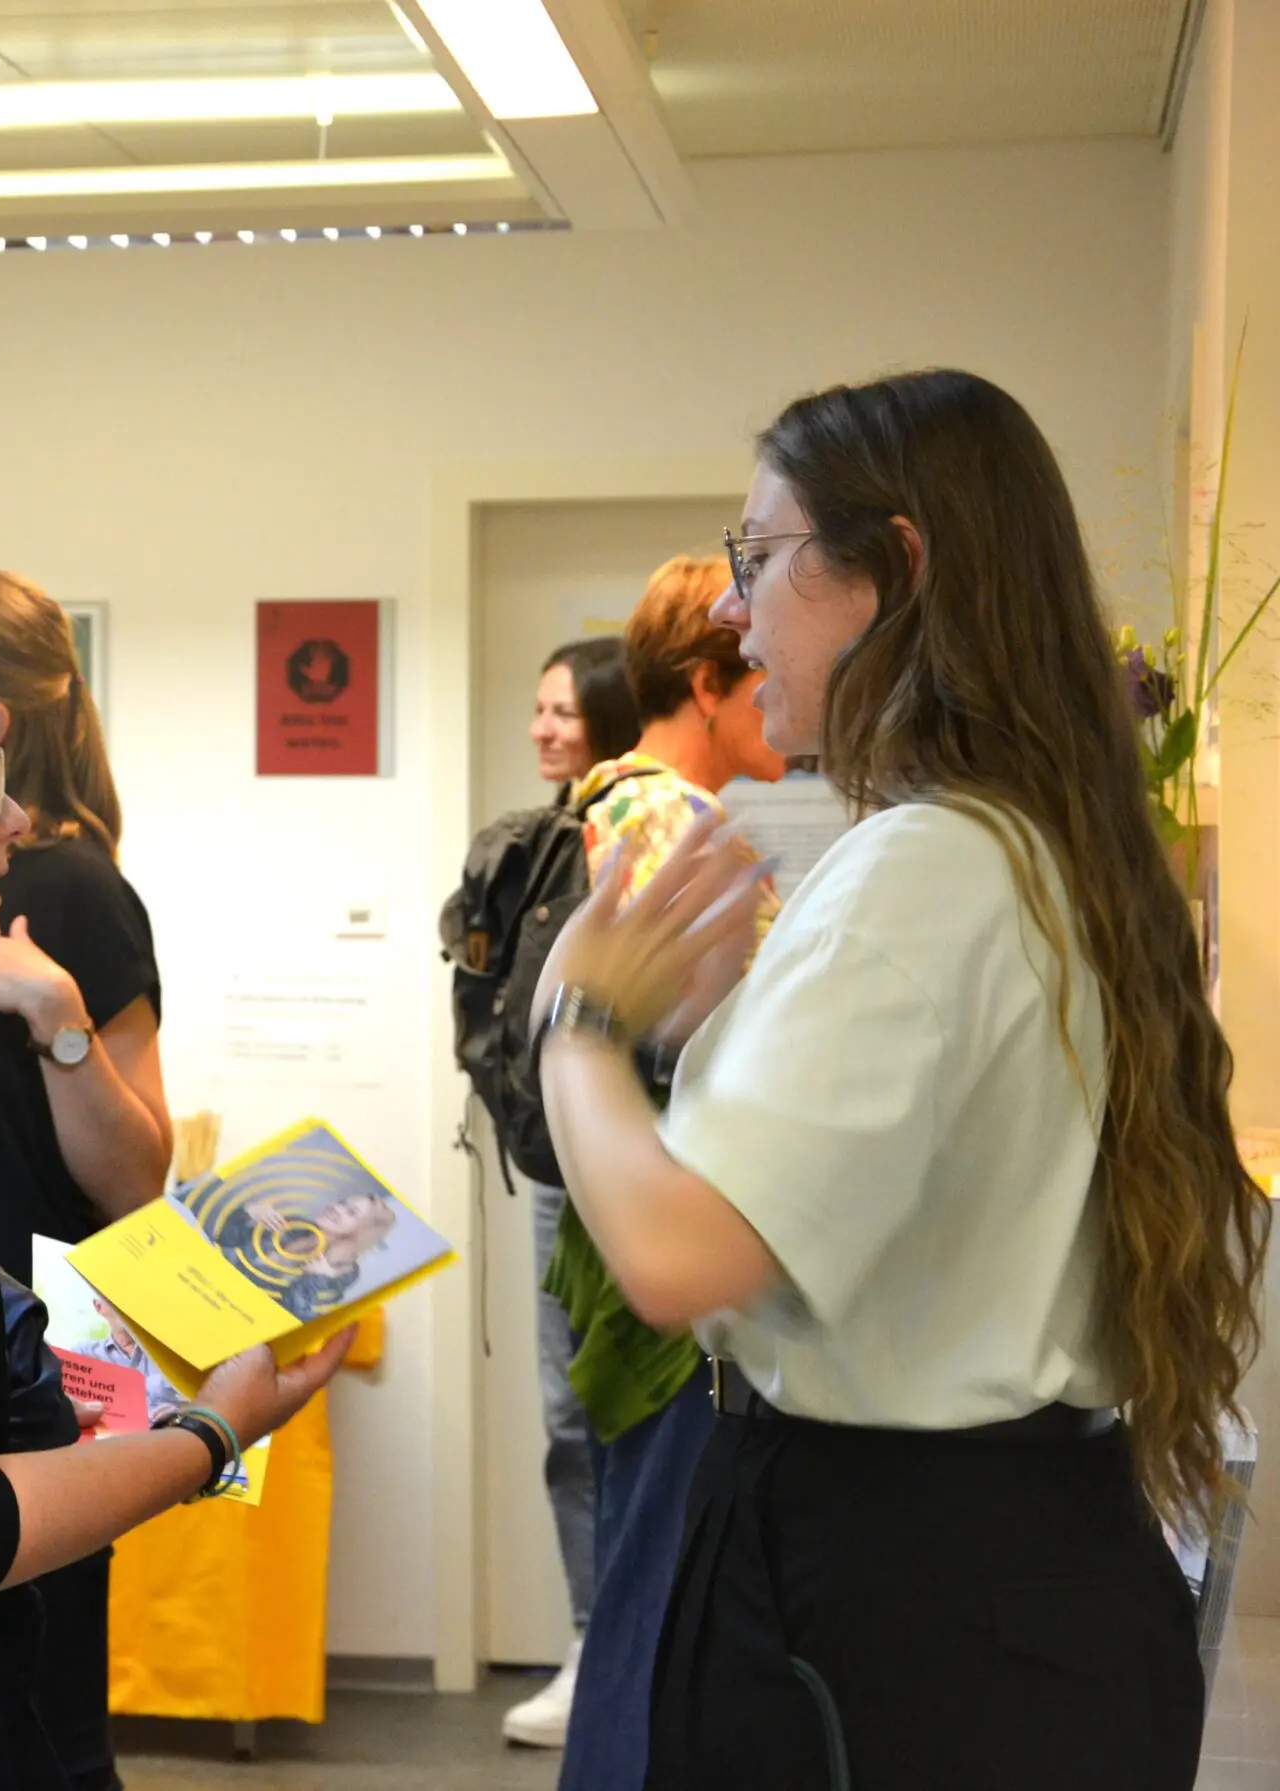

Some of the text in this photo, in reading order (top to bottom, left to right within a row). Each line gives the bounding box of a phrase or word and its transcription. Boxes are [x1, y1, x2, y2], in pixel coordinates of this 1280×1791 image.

[61, 1359, 93, 1375] sser
[62, 1372, 115, 1392] ren und
[63, 1385, 113, 1403] rstehen
